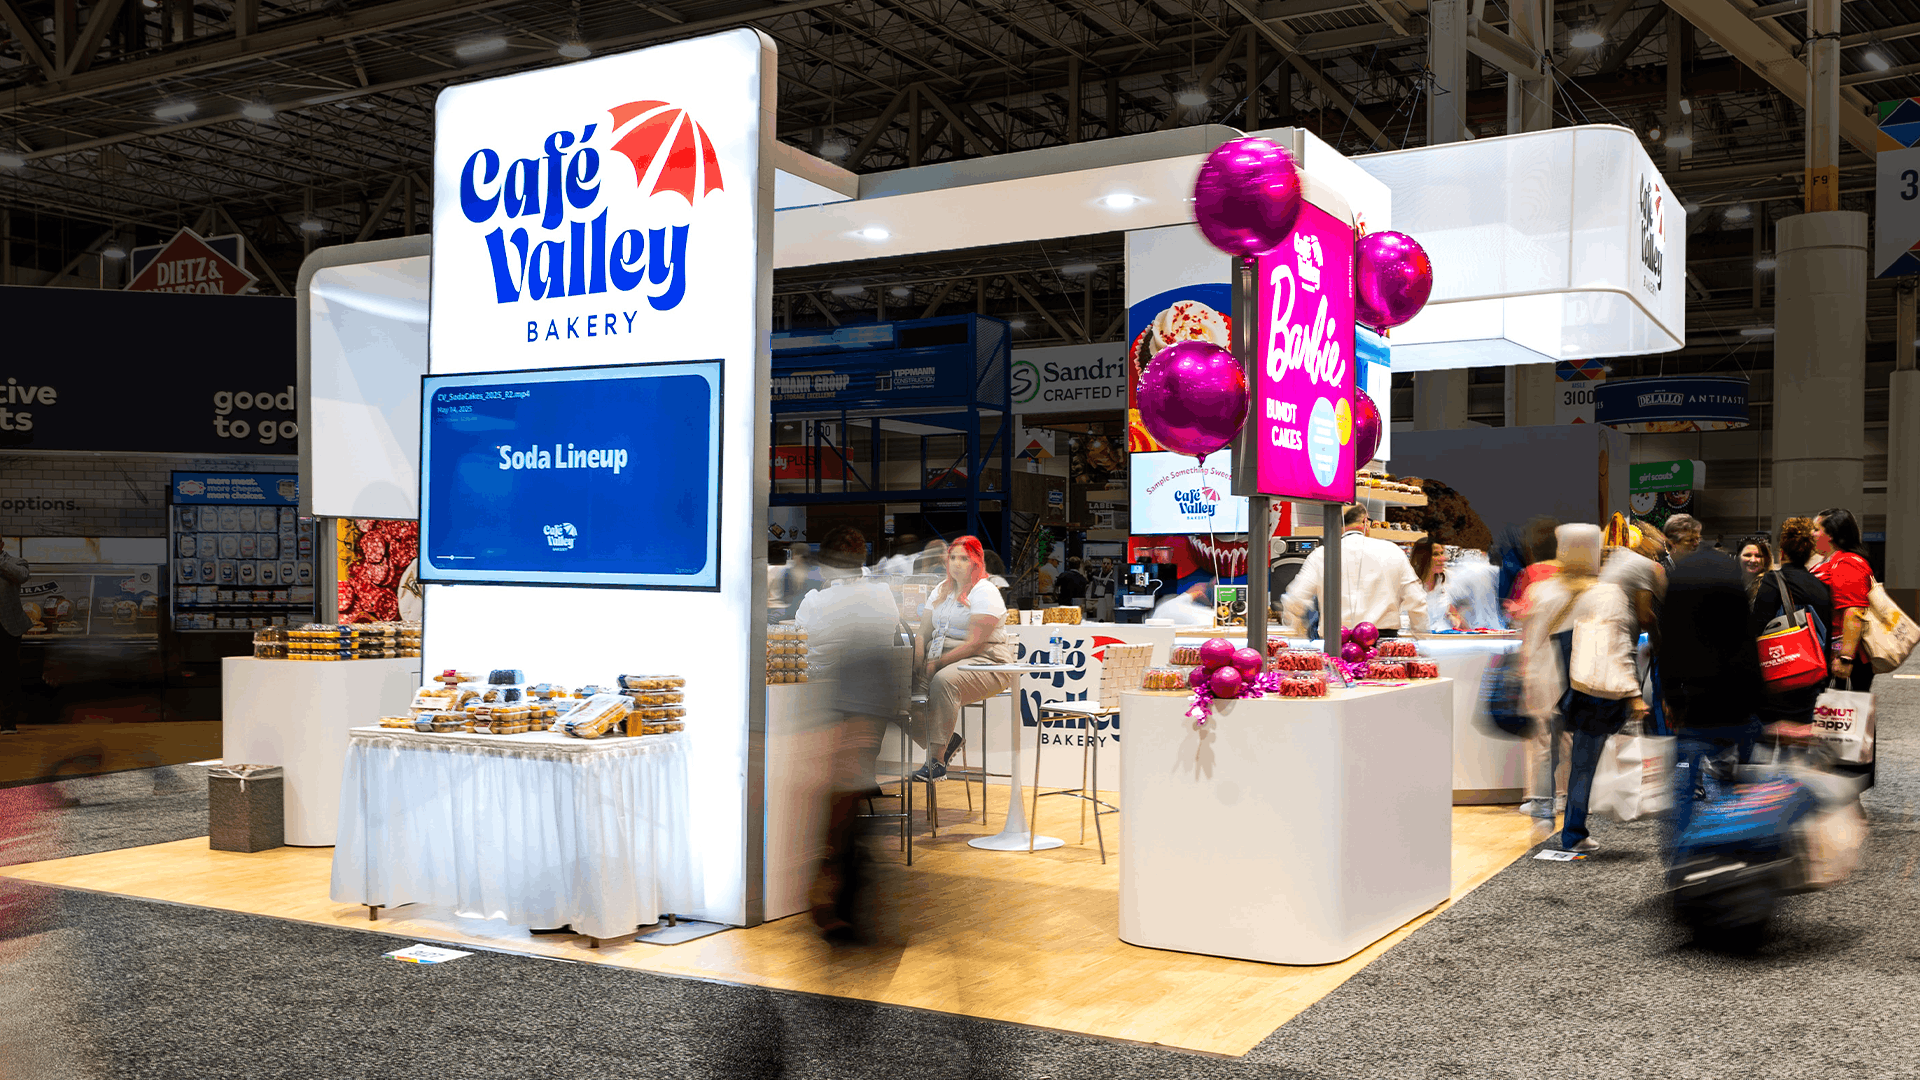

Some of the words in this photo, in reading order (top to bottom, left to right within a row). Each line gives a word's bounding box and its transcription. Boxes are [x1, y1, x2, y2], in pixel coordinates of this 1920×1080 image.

[460, 123, 601, 230] Café
[157, 257, 207, 286] DIETZ
[208, 260, 222, 279] &
[485, 206, 690, 310] Valley
[527, 310, 637, 342] BAKERY
[1267, 264, 1345, 384] Barbie
[1044, 357, 1125, 382] Sandri
[213, 386, 294, 415] good
[1044, 386, 1111, 401] CRAFTED
[1564, 390, 1595, 405] 3100
[1267, 398, 1297, 423] BUNDT
[213, 415, 250, 438] to
[258, 420, 299, 444] go
[1272, 426, 1302, 450] CAKES
[499, 444, 550, 470] Soda
[555, 442, 628, 474] Lineup
[1146, 474, 1170, 495] Sample
[1170, 466, 1209, 480] Something
[1, 496, 81, 513] options.
[1174, 489, 1201, 504] Café
[1179, 501, 1216, 517] Valley
[1041, 733, 1107, 747] BAKERY
